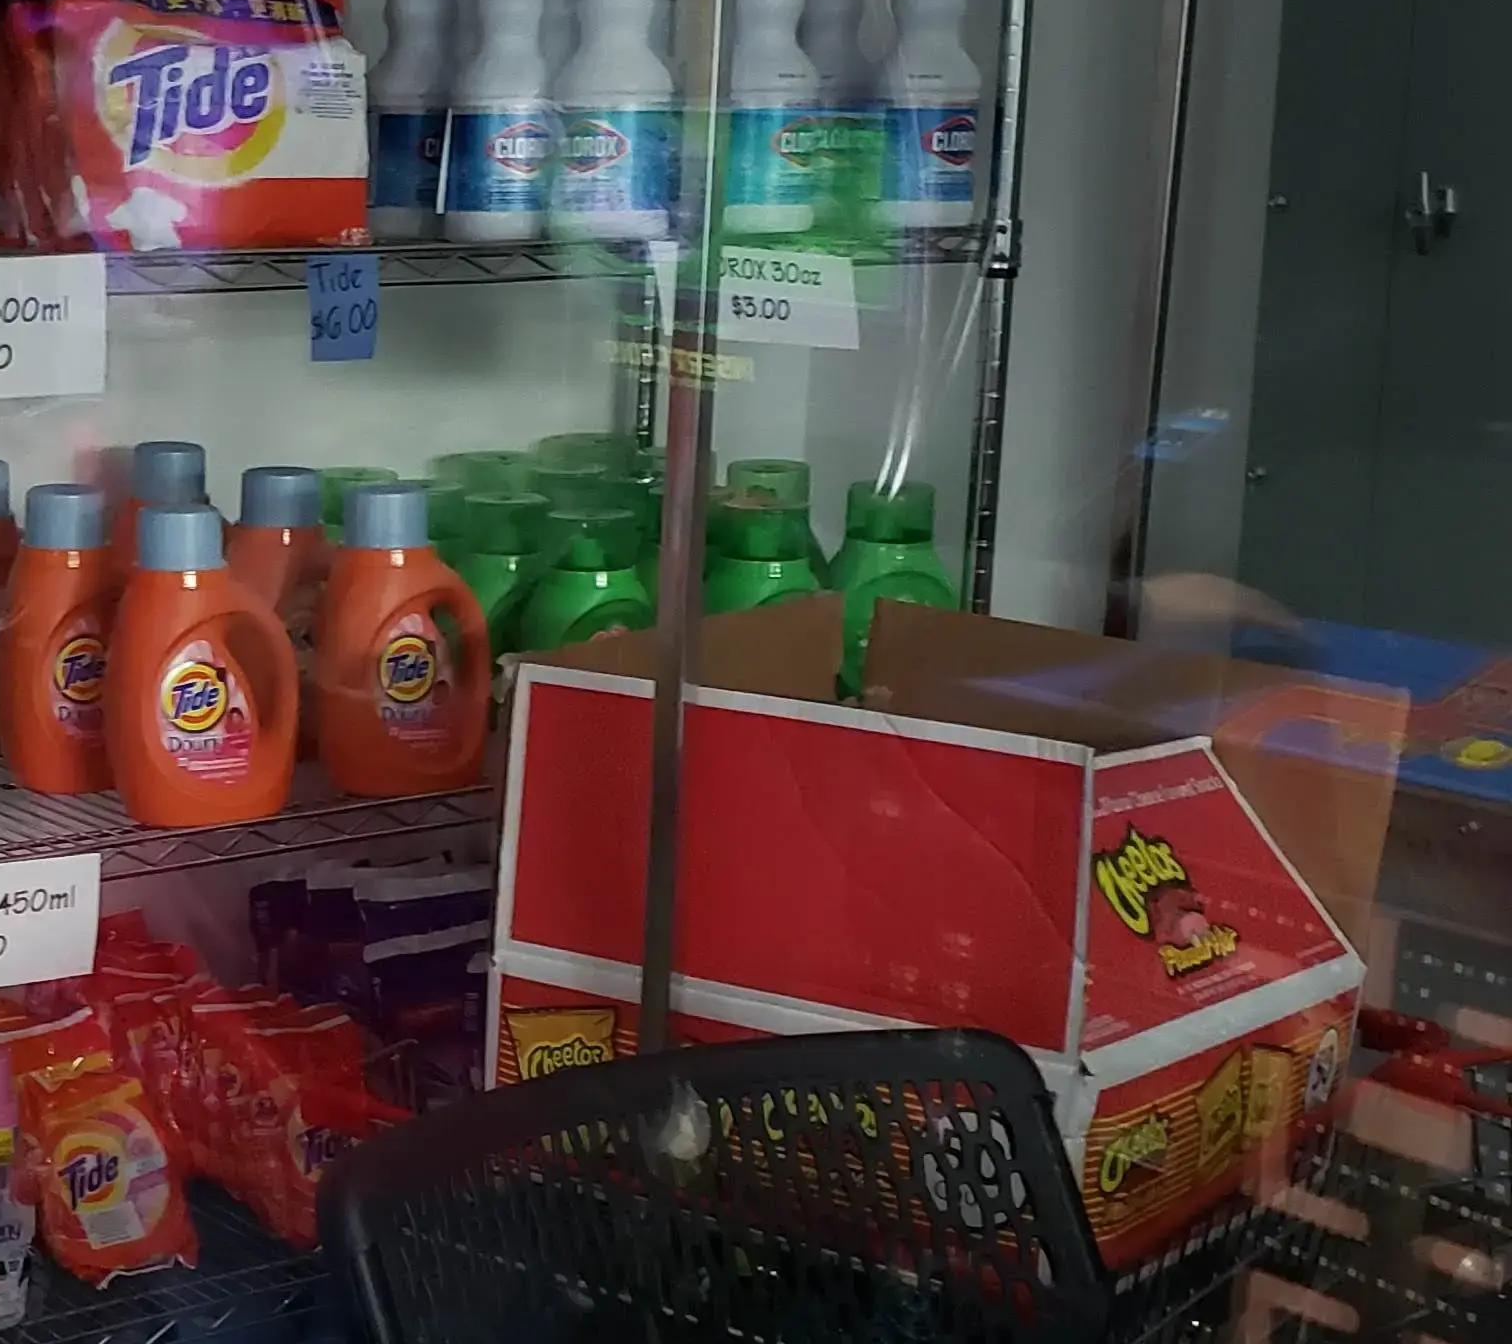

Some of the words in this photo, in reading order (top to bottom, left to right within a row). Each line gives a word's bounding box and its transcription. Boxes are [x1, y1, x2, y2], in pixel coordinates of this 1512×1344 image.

[109, 44, 269, 166] Tide
[310, 261, 363, 293] Tide
[771, 259, 823, 287] 30oz
[730, 294, 791, 322] $3.00
[386, 653, 429, 685] Tide
[171, 681, 220, 721] Tide
[57, 1154, 120, 1212] Tide
